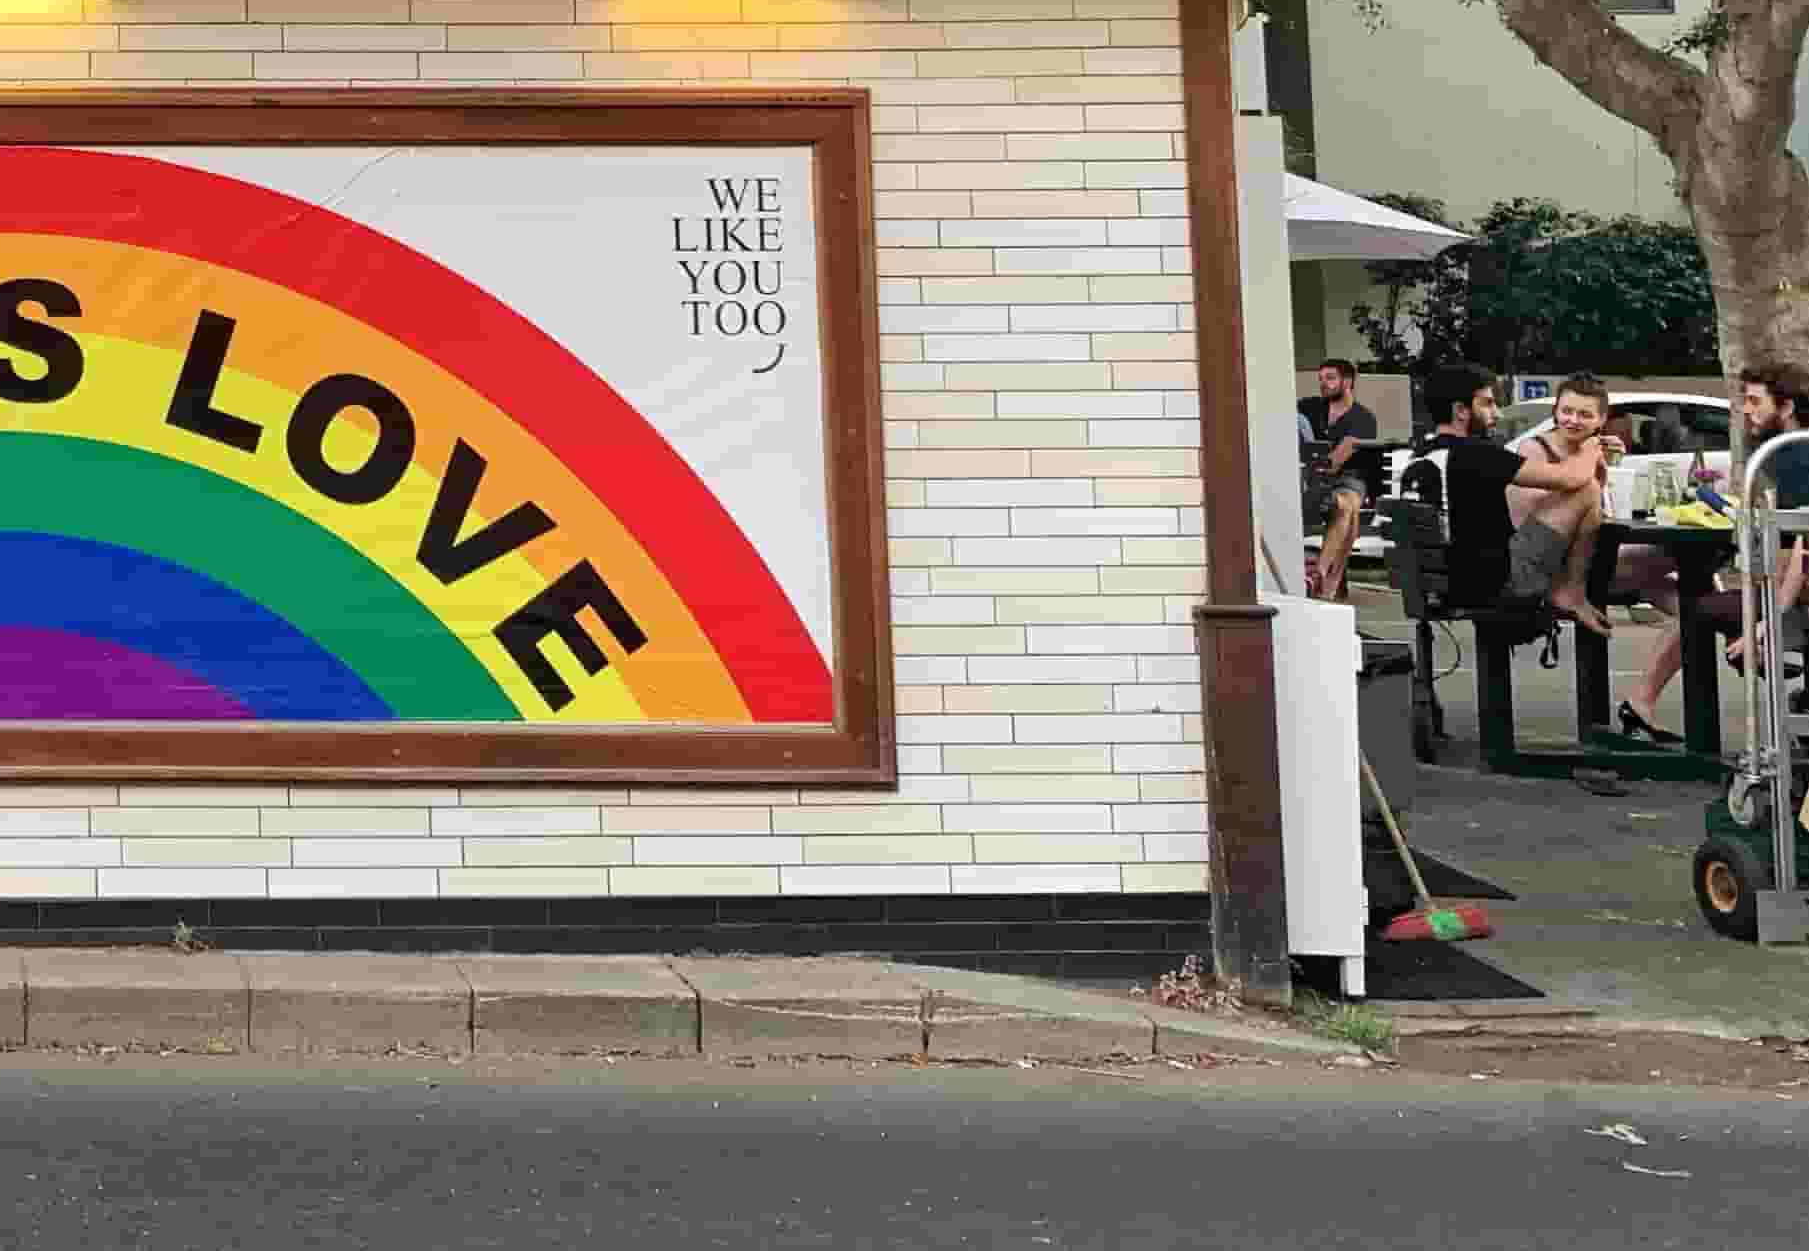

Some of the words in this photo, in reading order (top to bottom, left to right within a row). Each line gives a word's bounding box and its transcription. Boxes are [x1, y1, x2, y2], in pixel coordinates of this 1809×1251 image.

[705, 178, 782, 213] WE
[672, 217, 784, 252] LIKE
[676, 260, 783, 295] YOU
[681, 300, 787, 336] TOO
[165, 308, 649, 712] LOVE
